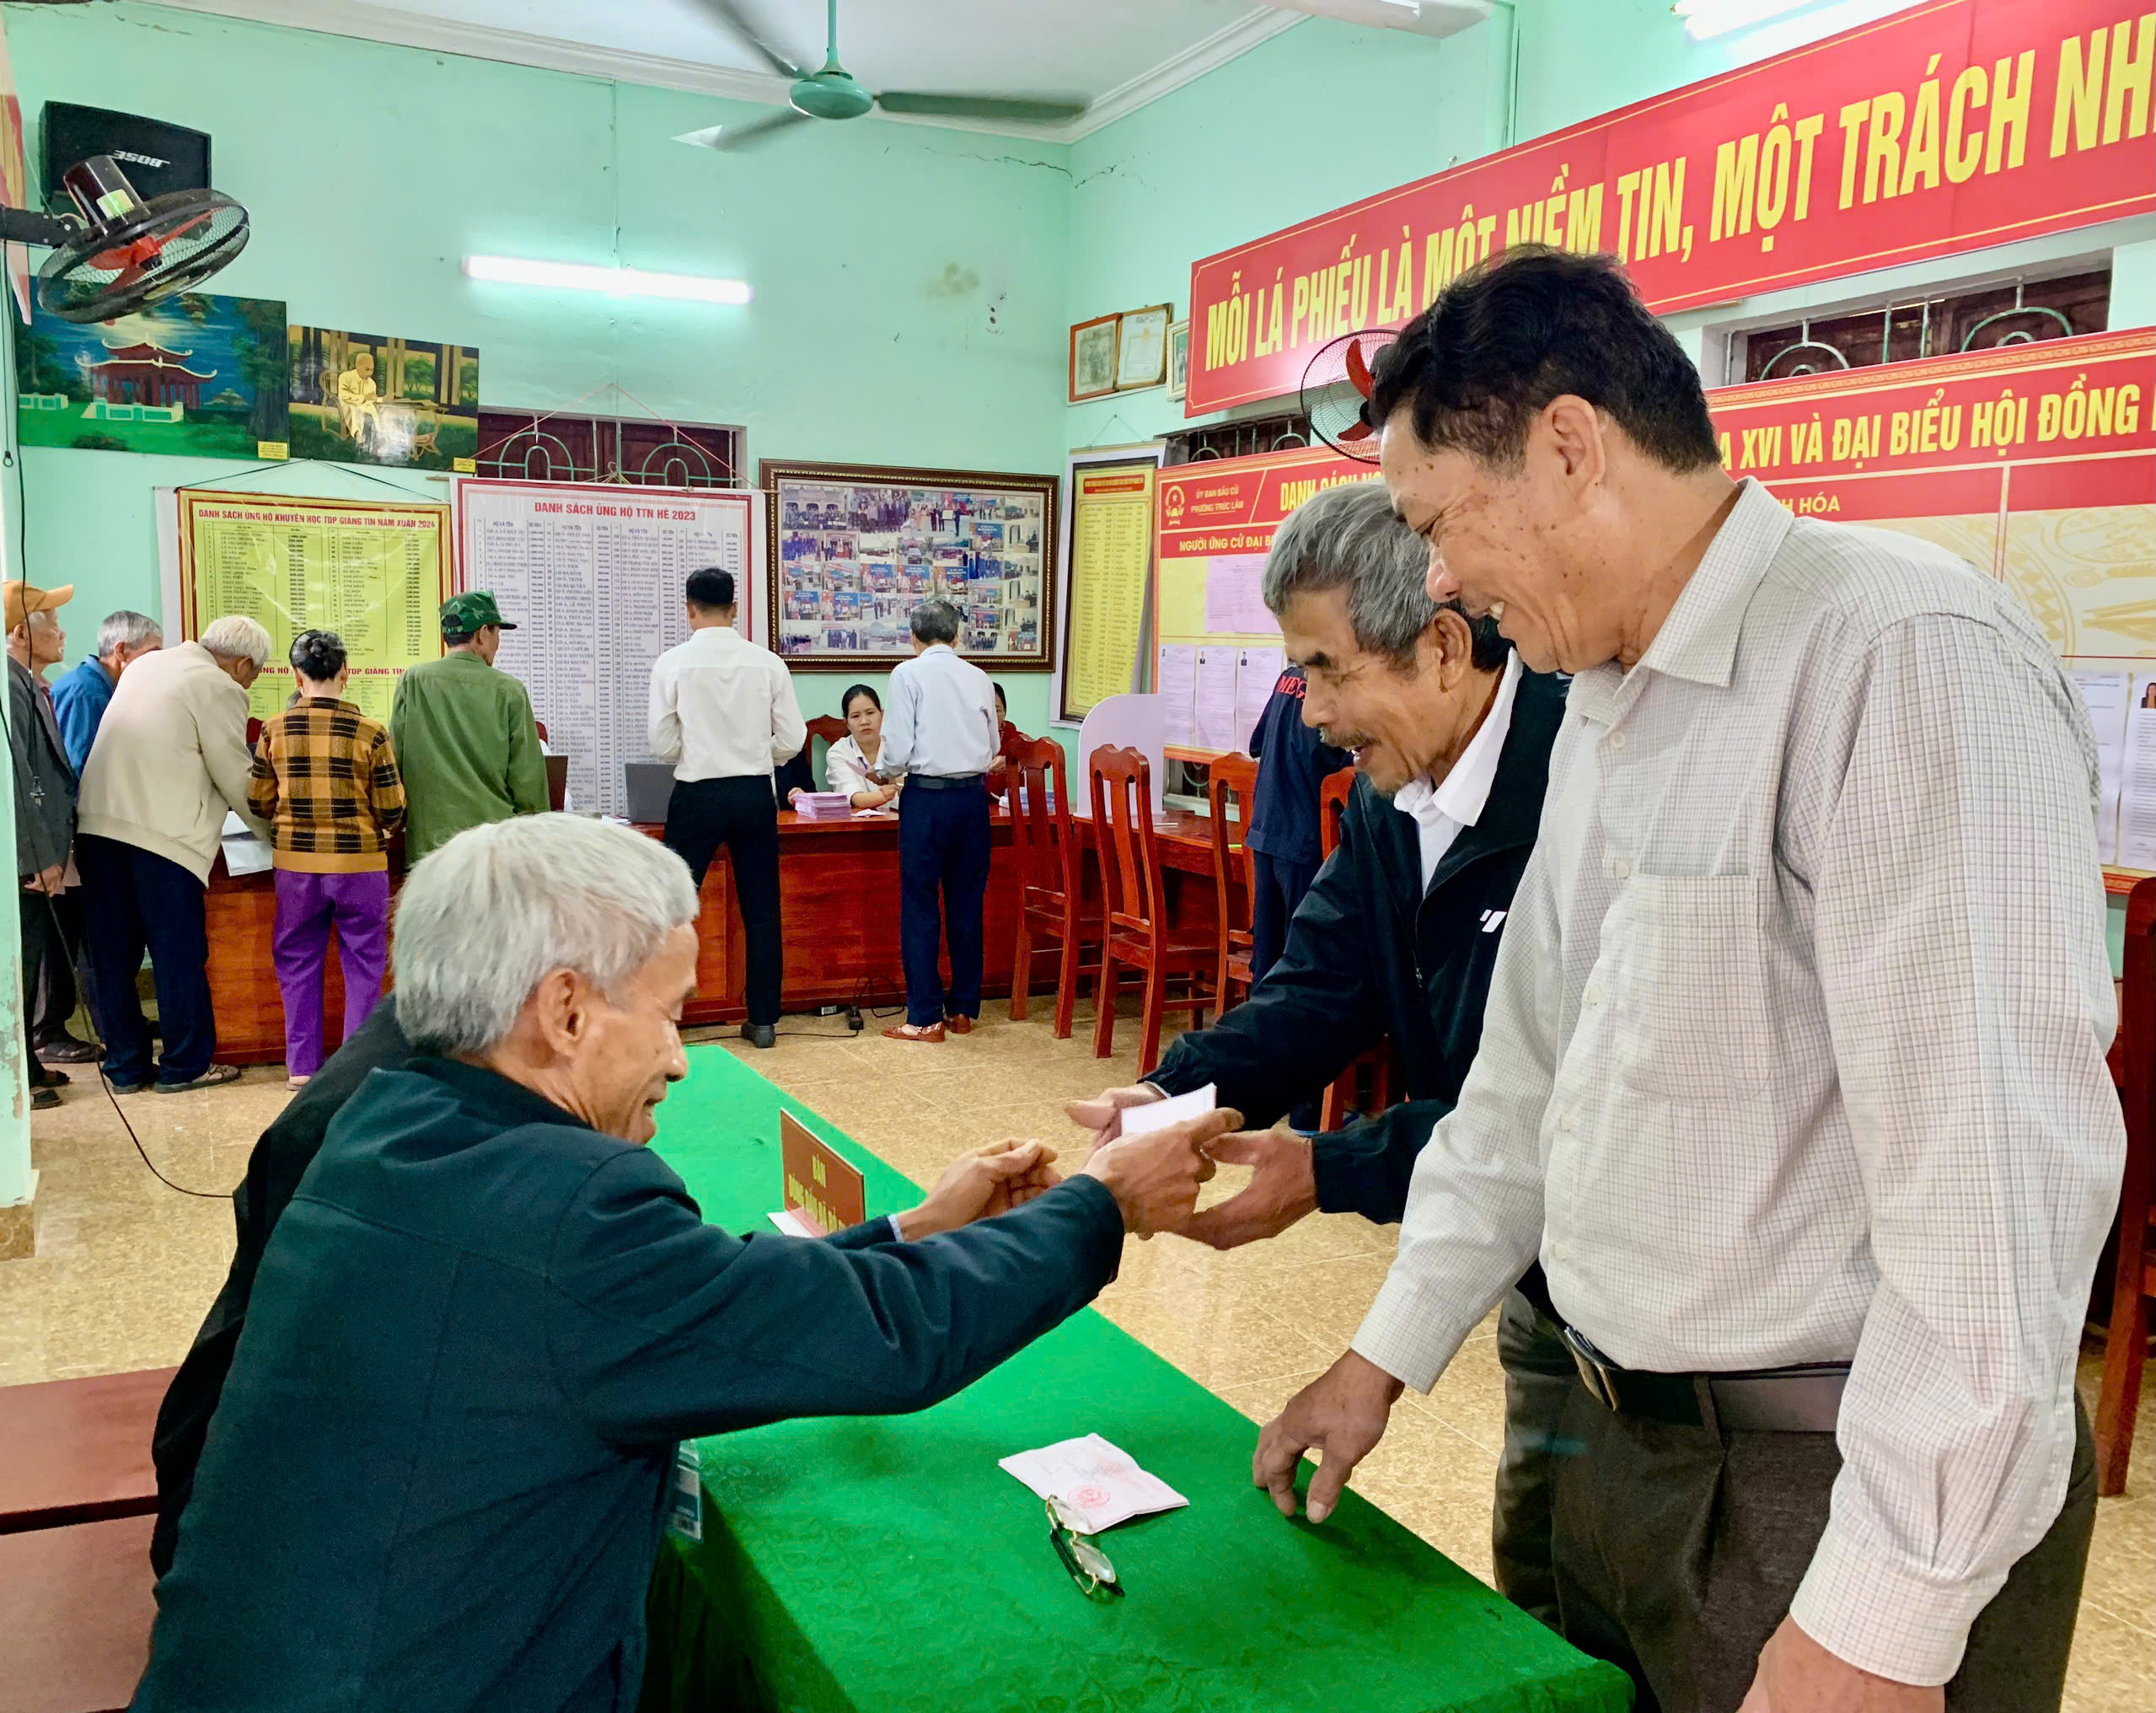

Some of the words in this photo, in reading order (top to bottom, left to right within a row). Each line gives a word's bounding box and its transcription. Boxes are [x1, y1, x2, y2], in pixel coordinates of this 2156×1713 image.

[113, 149, 171, 168] BOSE
[1205, 270, 1250, 372] MỖI
[1254, 266, 1284, 358] LÁ
[1290, 234, 1371, 350] PHIẾU
[1376, 224, 1413, 326] LÀ
[1617, 156, 1694, 264] TIN,
[1708, 102, 1826, 253] MỘT
[1838, 52, 2036, 211] TRÁCH
[2049, 13, 2156, 158] NH
[1739, 426, 1783, 470] XVI
[1790, 412, 1823, 464] VÀ
[1832, 414, 1882, 469] ĐẠI
[1889, 388, 1963, 457] BIỂU
[1971, 388, 2029, 457] HỘI
[2037, 373, 2141, 442] ĐỒNG
[534, 502, 563, 513] DANH
[566, 502, 593, 514] SÁCH
[620, 507, 632, 519] HỘ
[636, 508, 653, 518] TTN
[672, 510, 696, 521] 2023
[1799, 491, 1841, 513] HÓA
[199, 509, 219, 518] DANH
[418, 519, 436, 528] 2024
[1180, 537, 1207, 551] NGƯỜI
[1209, 535, 1228, 550] ỨNG
[1231, 533, 1245, 548] CỬ
[1247, 535, 1263, 550] ĐẠI
